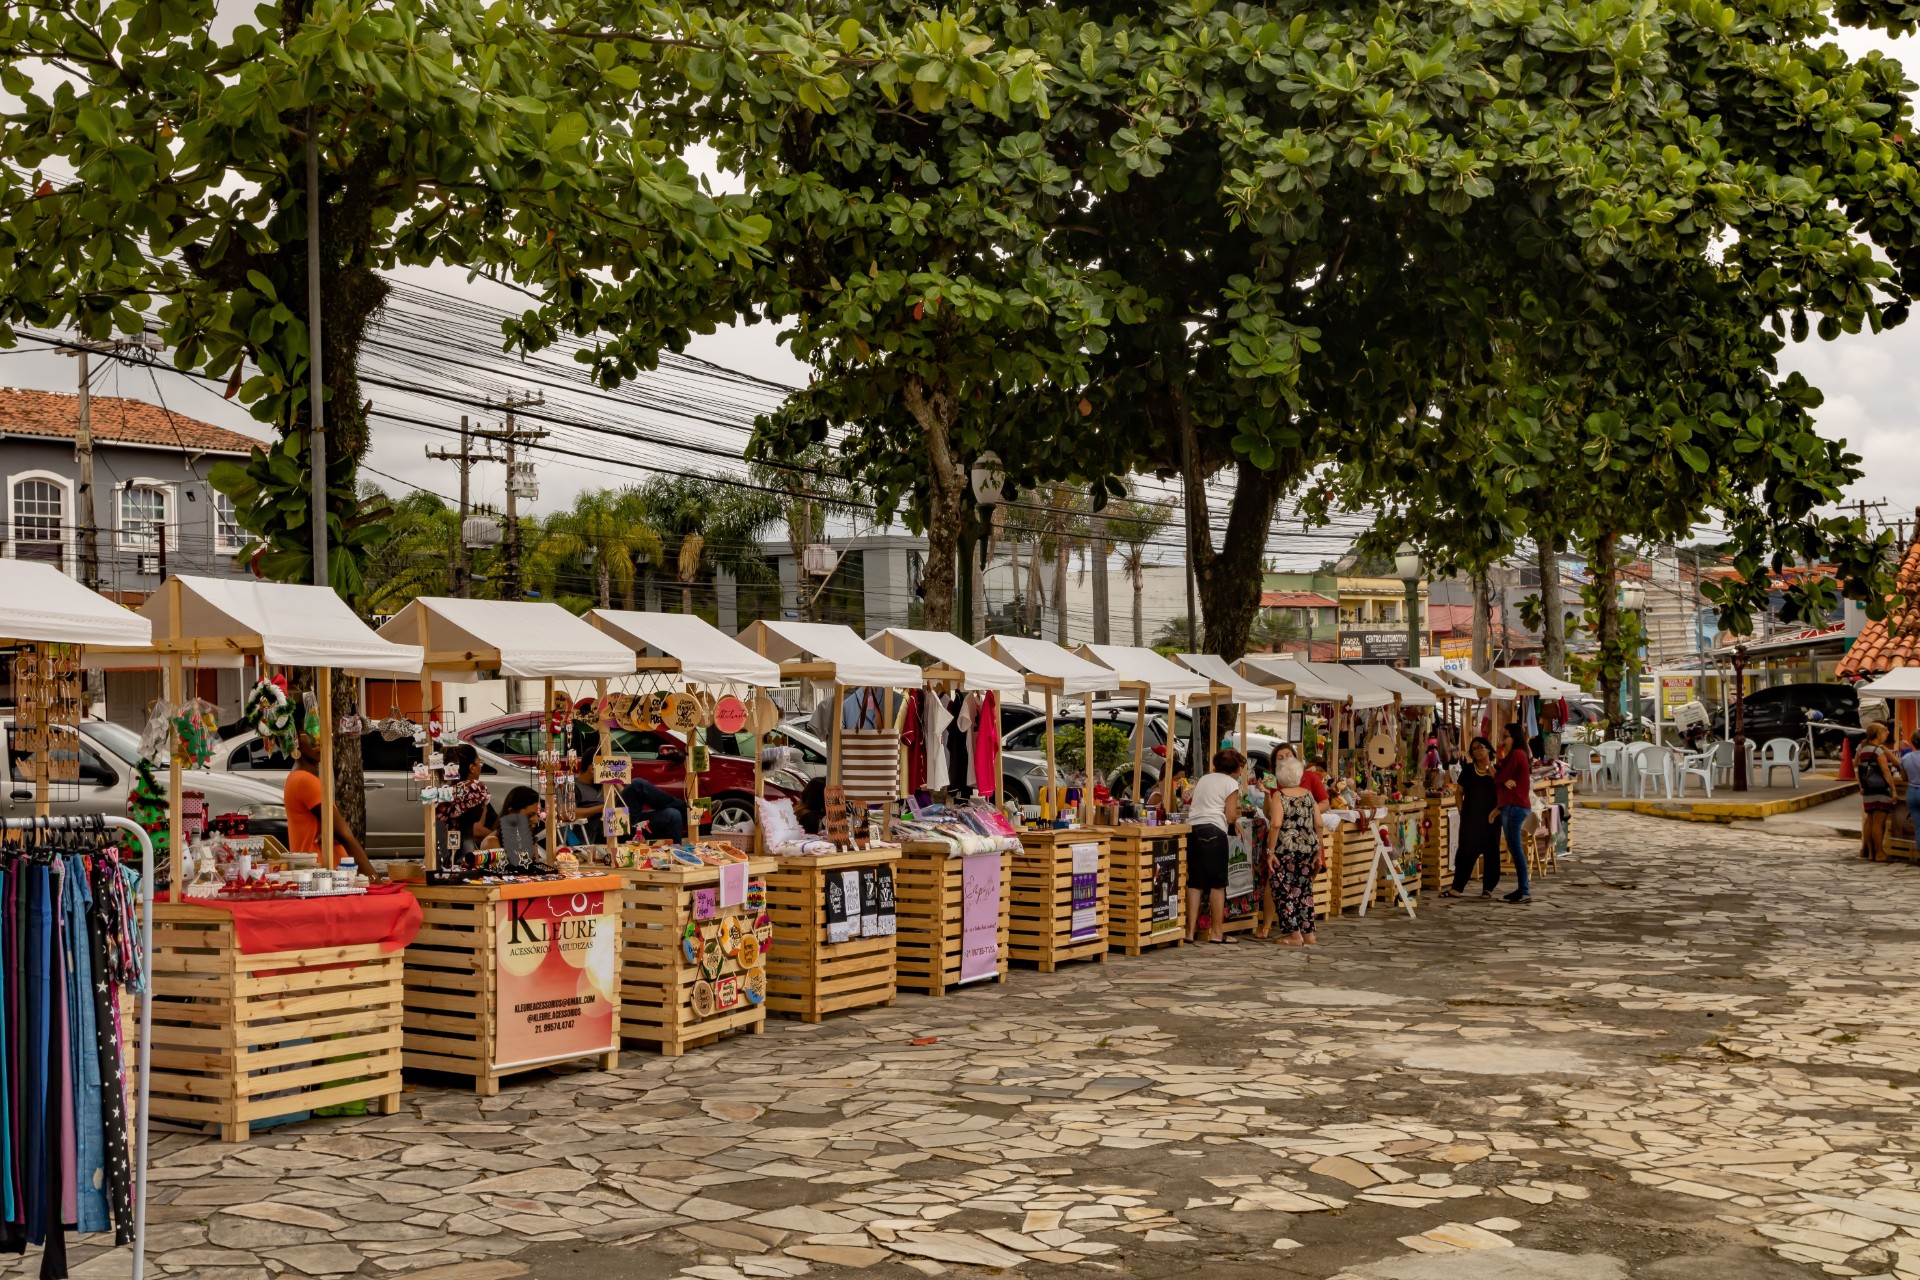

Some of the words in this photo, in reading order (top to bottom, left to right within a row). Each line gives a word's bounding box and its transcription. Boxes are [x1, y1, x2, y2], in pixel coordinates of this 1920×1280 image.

[1365, 634, 1381, 644] CENTRO
[1382, 634, 1407, 643] AUTOMOTIVO
[508, 898, 597, 944] KLEURE
[509, 944, 552, 957] ACESSÓRIOS
[558, 942, 594, 952] MIUDEZAS
